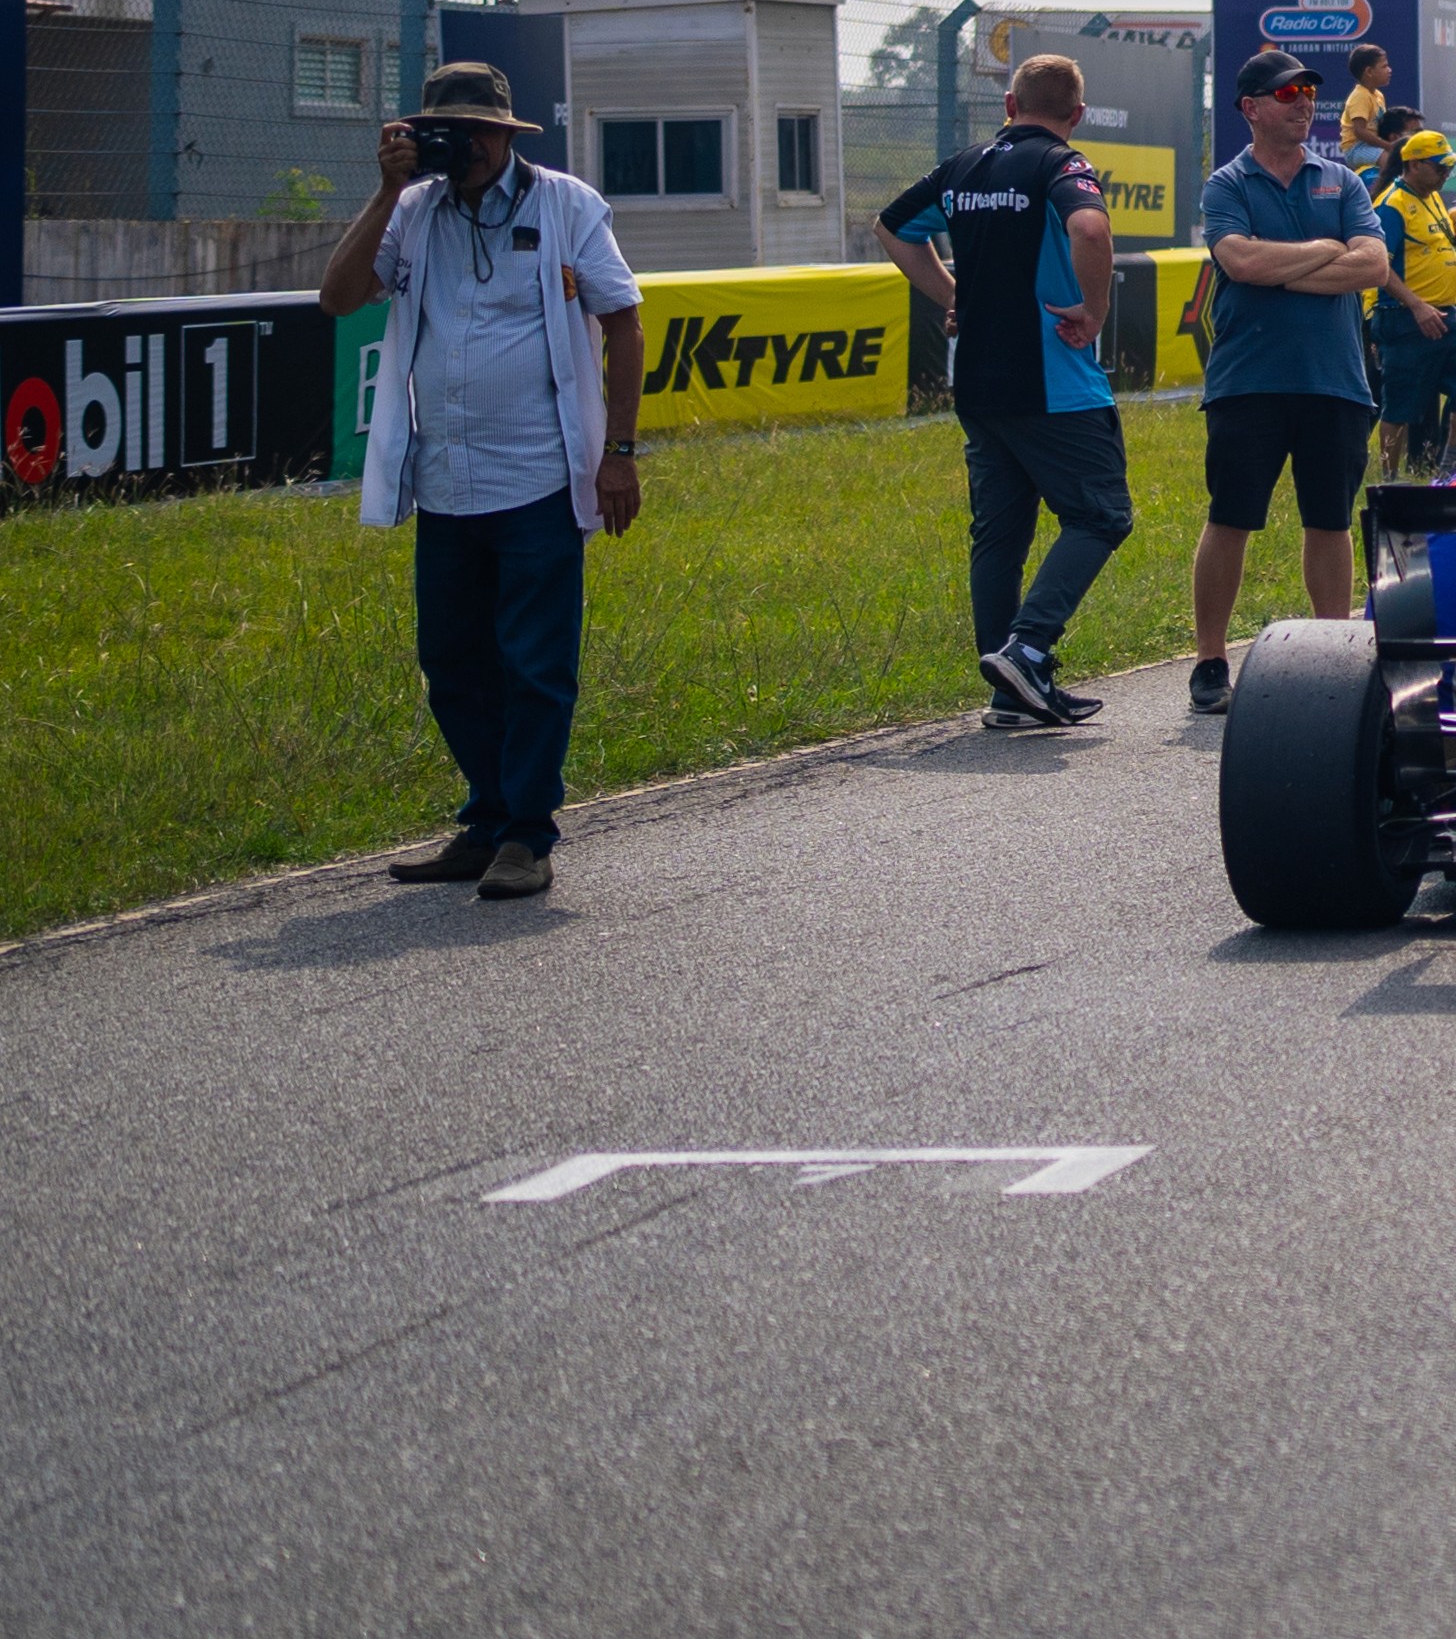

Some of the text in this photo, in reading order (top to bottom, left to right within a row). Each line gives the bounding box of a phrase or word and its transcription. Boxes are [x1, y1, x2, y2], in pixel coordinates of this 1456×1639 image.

[1270, 15, 1355, 36] Radio City
[1288, 43, 1320, 53] JAGRAN
[1322, 43, 1357, 52] INITIAT
[1086, 106, 1129, 128] POWERED BY
[6, 333, 166, 485] obil
[205, 337, 229, 449] 1
